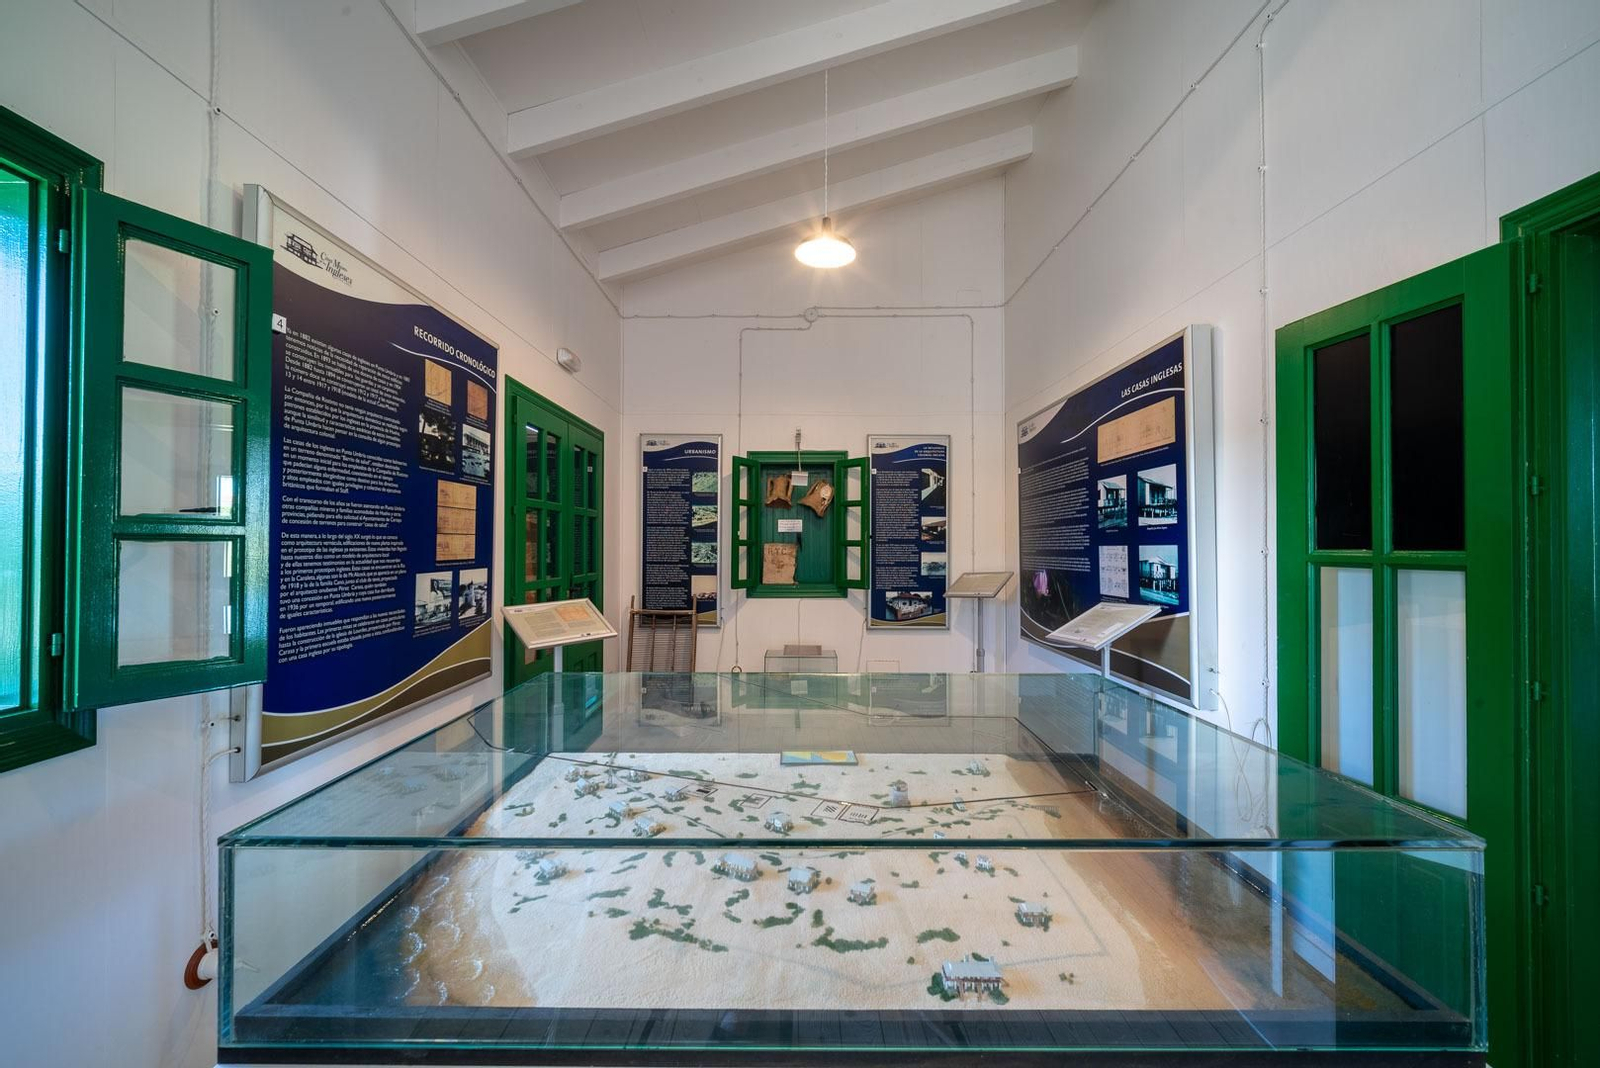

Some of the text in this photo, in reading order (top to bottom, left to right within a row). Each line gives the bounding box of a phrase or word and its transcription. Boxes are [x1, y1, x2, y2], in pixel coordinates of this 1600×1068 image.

[326, 262, 352, 285] Ingleses
[276, 318, 282, 328] 4
[413, 325, 496, 379] RECORRIDO CRONOLÓGICO
[1121, 362, 1183, 399] LAS CASAS INGLESAS
